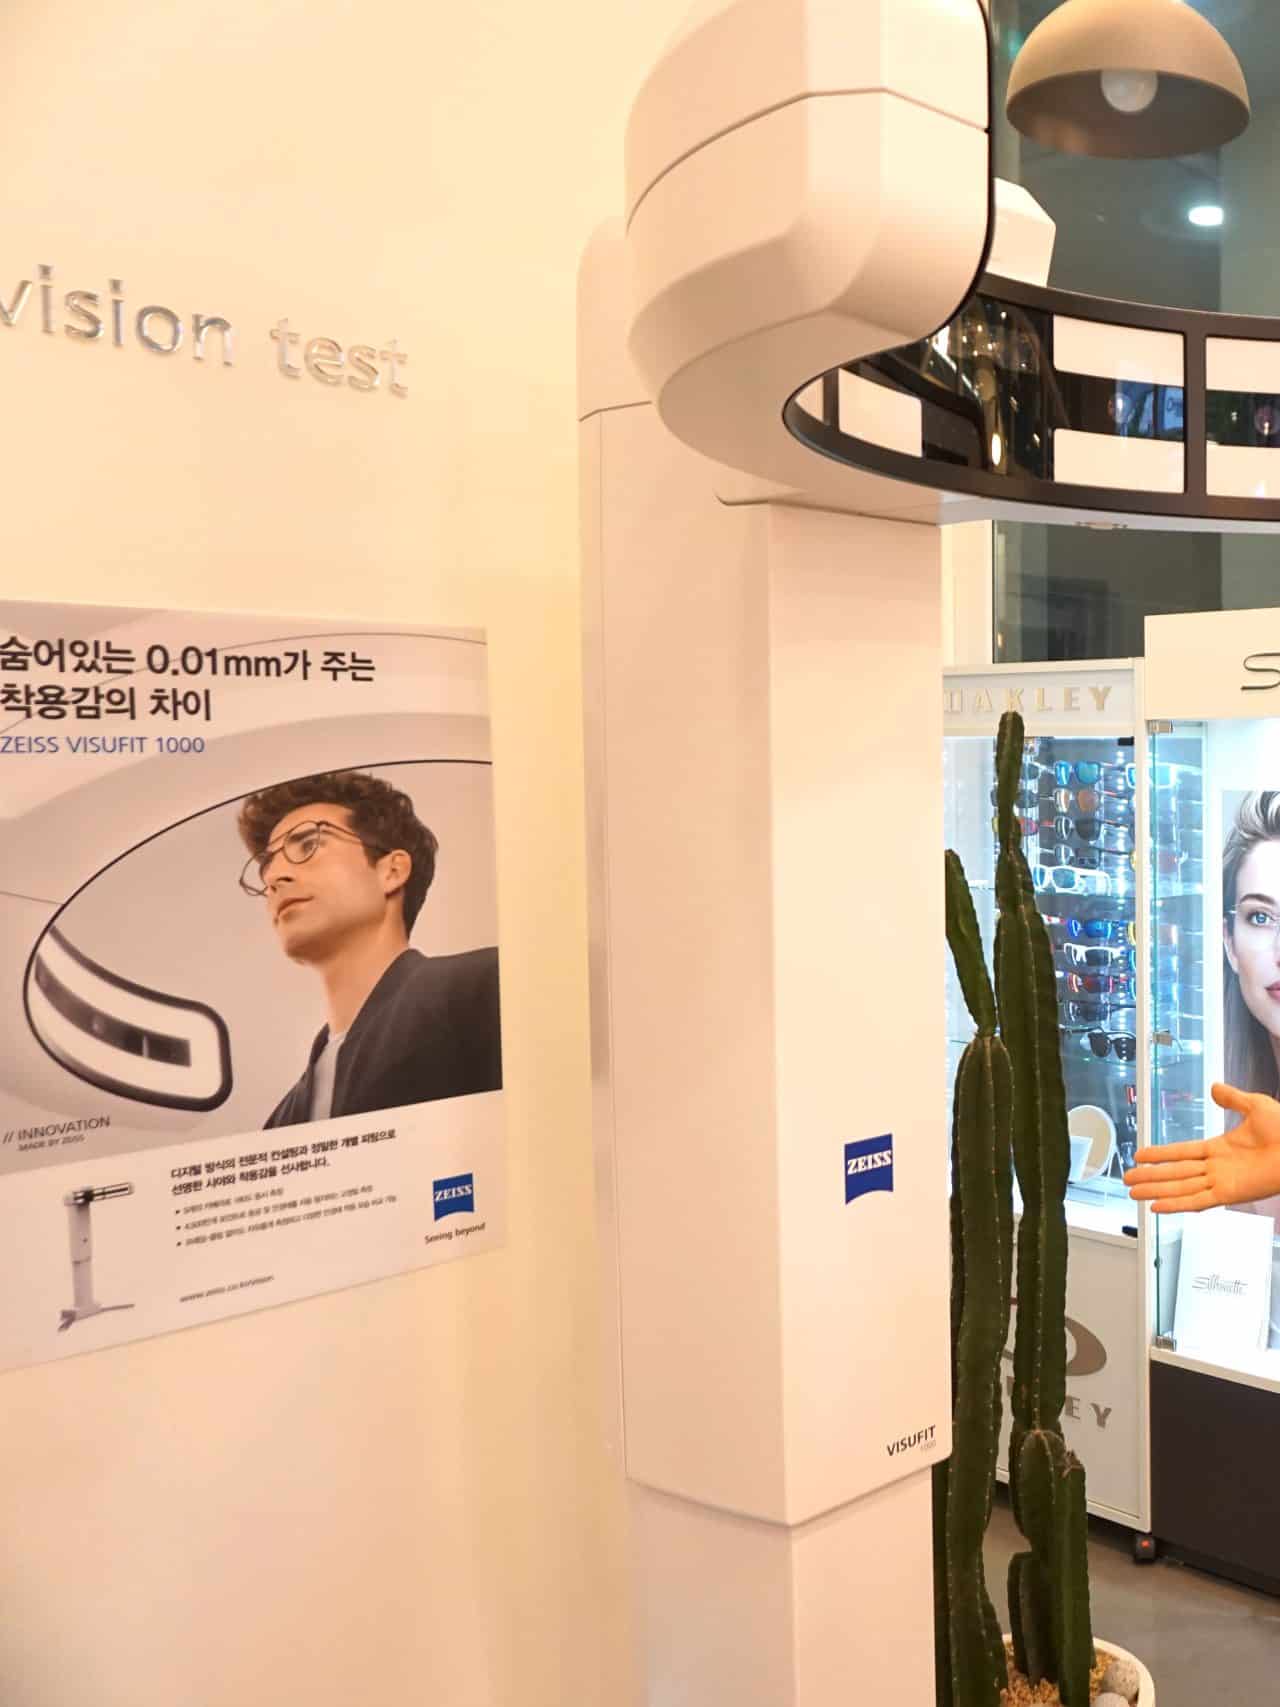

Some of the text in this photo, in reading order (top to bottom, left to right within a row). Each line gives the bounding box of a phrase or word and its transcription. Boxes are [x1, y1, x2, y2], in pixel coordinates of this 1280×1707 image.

[268, 318, 408, 399] test
[0, 635, 376, 682] 숨어있는 0.01mm가 주는
[0, 683, 212, 721] 착용감의 차이
[1, 736, 206, 754] ZEISS VISUFIT 1000
[17, 1115, 111, 1141] INNOVATION
[847, 1150, 893, 1176] ZEISS
[435, 1184, 473, 1203] ZEISS
[424, 1221, 486, 1245] Seeing beyond
[1191, 1273, 1249, 1296] Silhouette
[886, 1424, 936, 1457] VISUFIT
